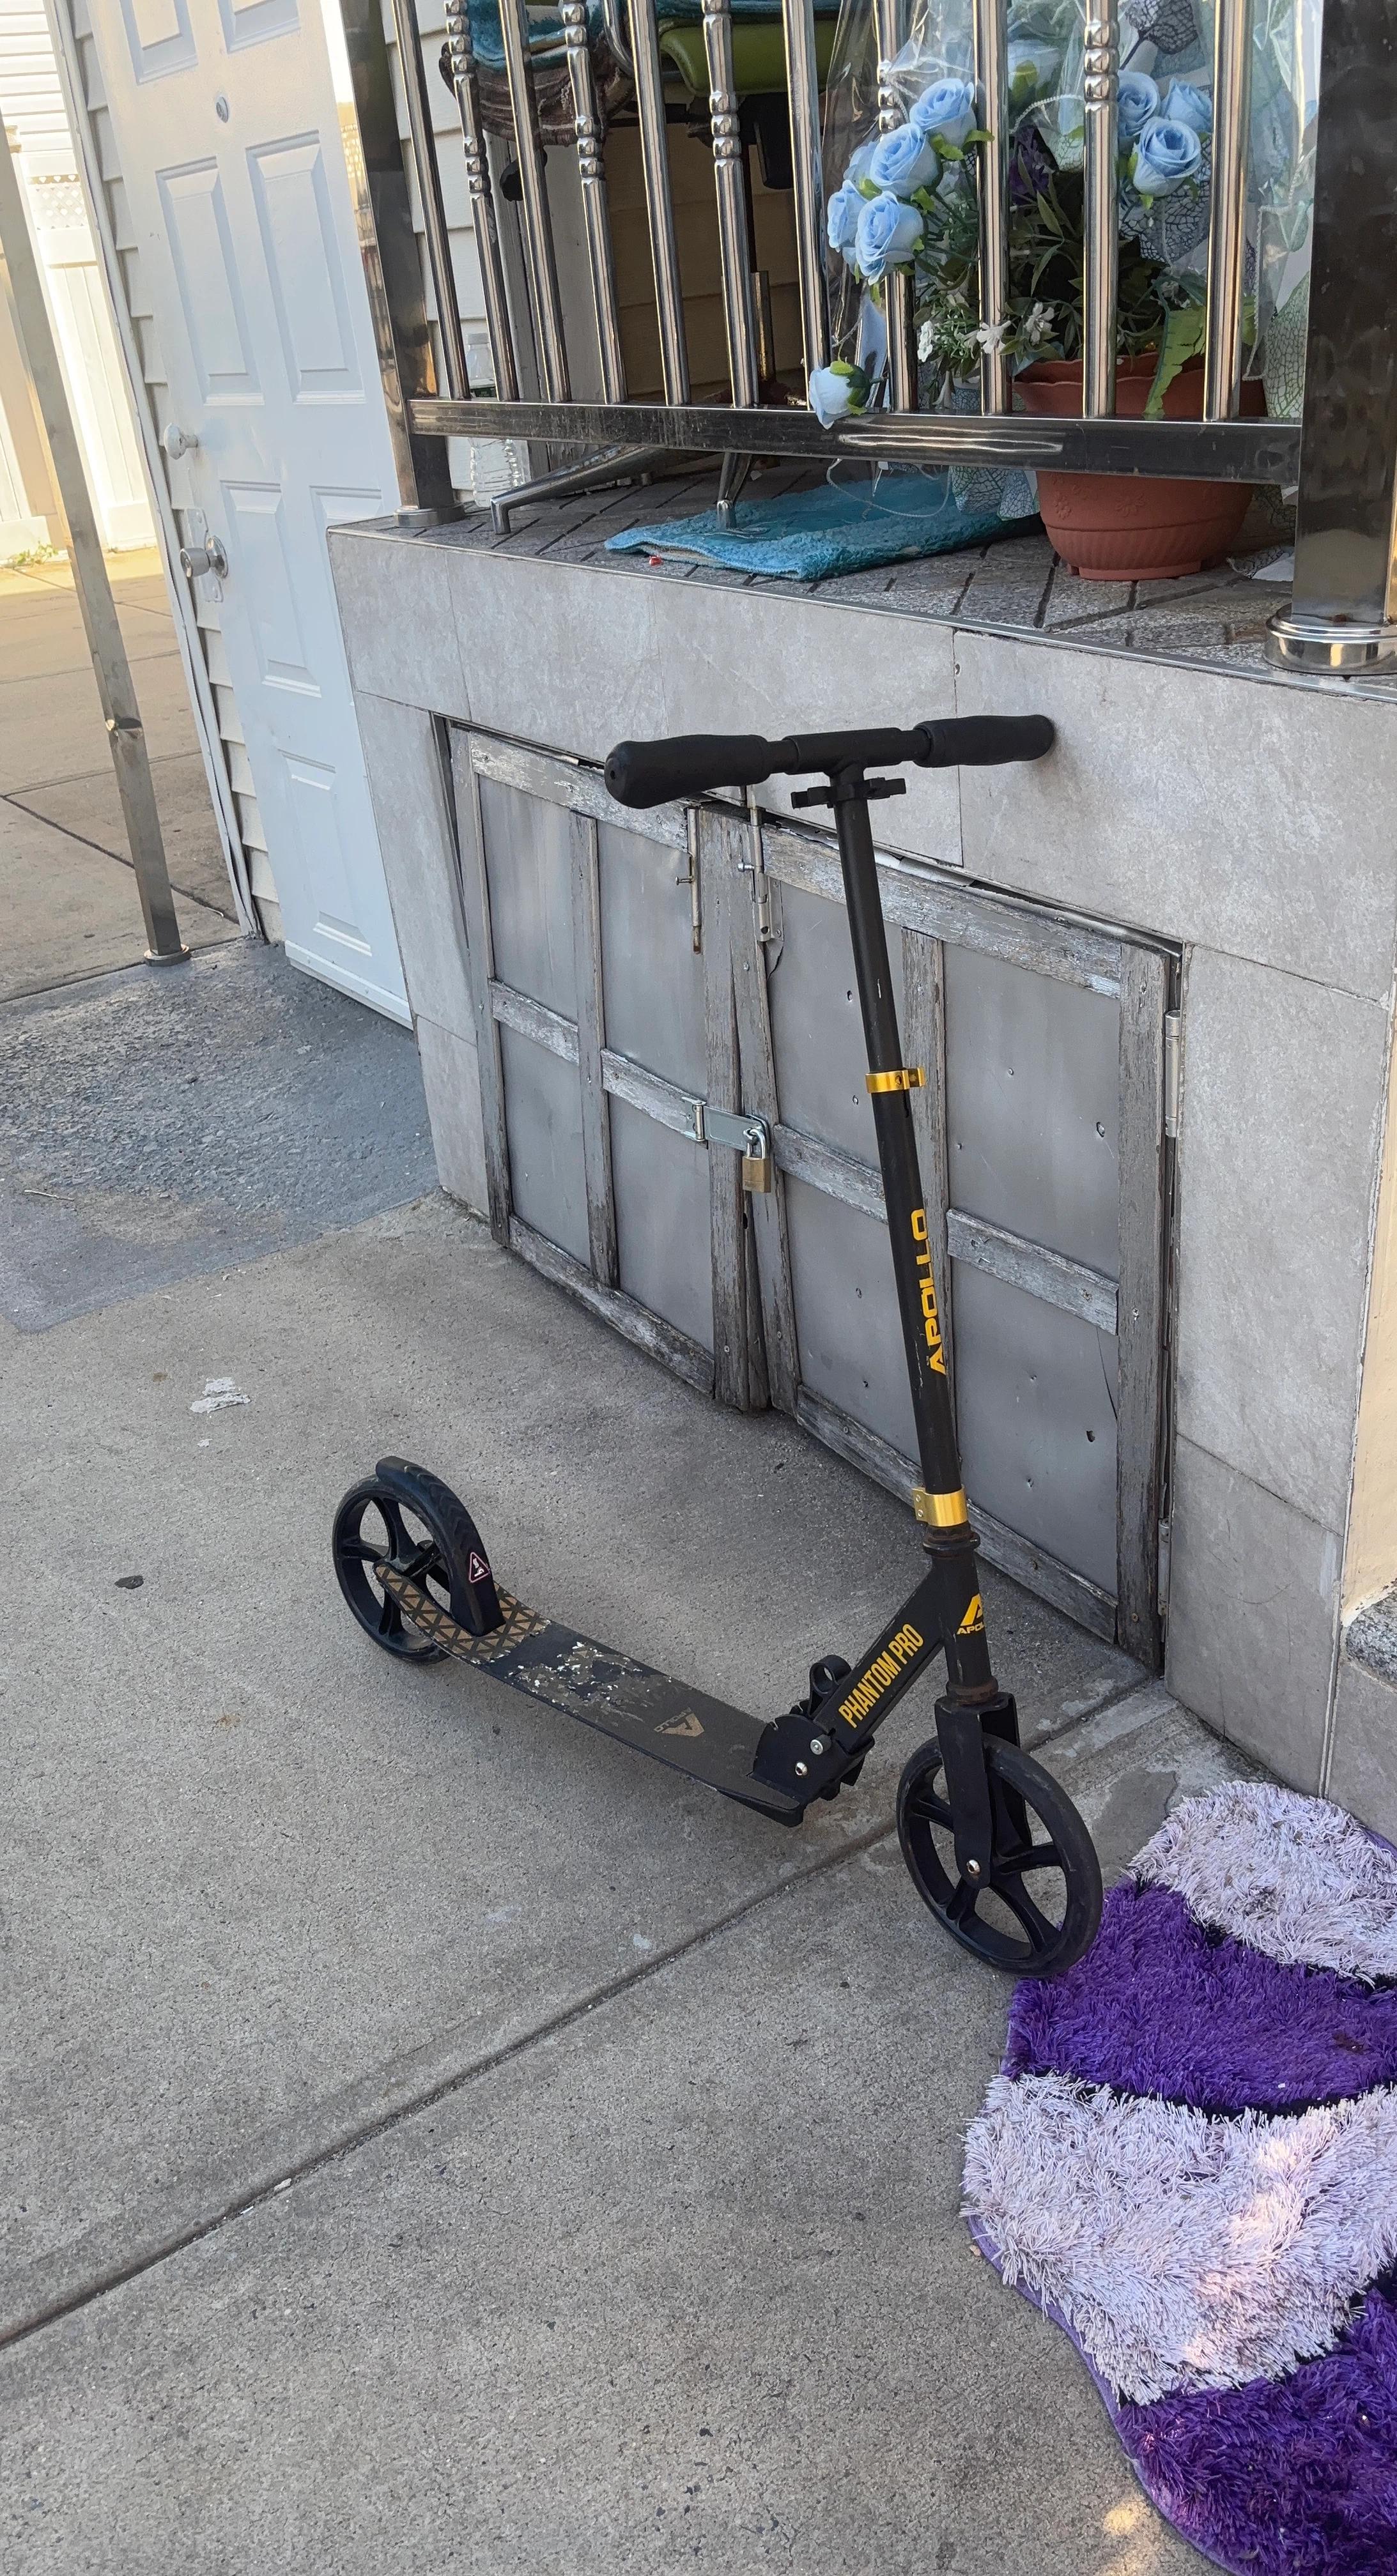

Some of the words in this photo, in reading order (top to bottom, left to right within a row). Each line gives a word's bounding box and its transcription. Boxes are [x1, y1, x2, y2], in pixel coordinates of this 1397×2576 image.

[910, 1208, 947, 1376] APOLLO
[838, 1650, 902, 1729] PHANTOM
[888, 1623, 924, 1665] PRO
